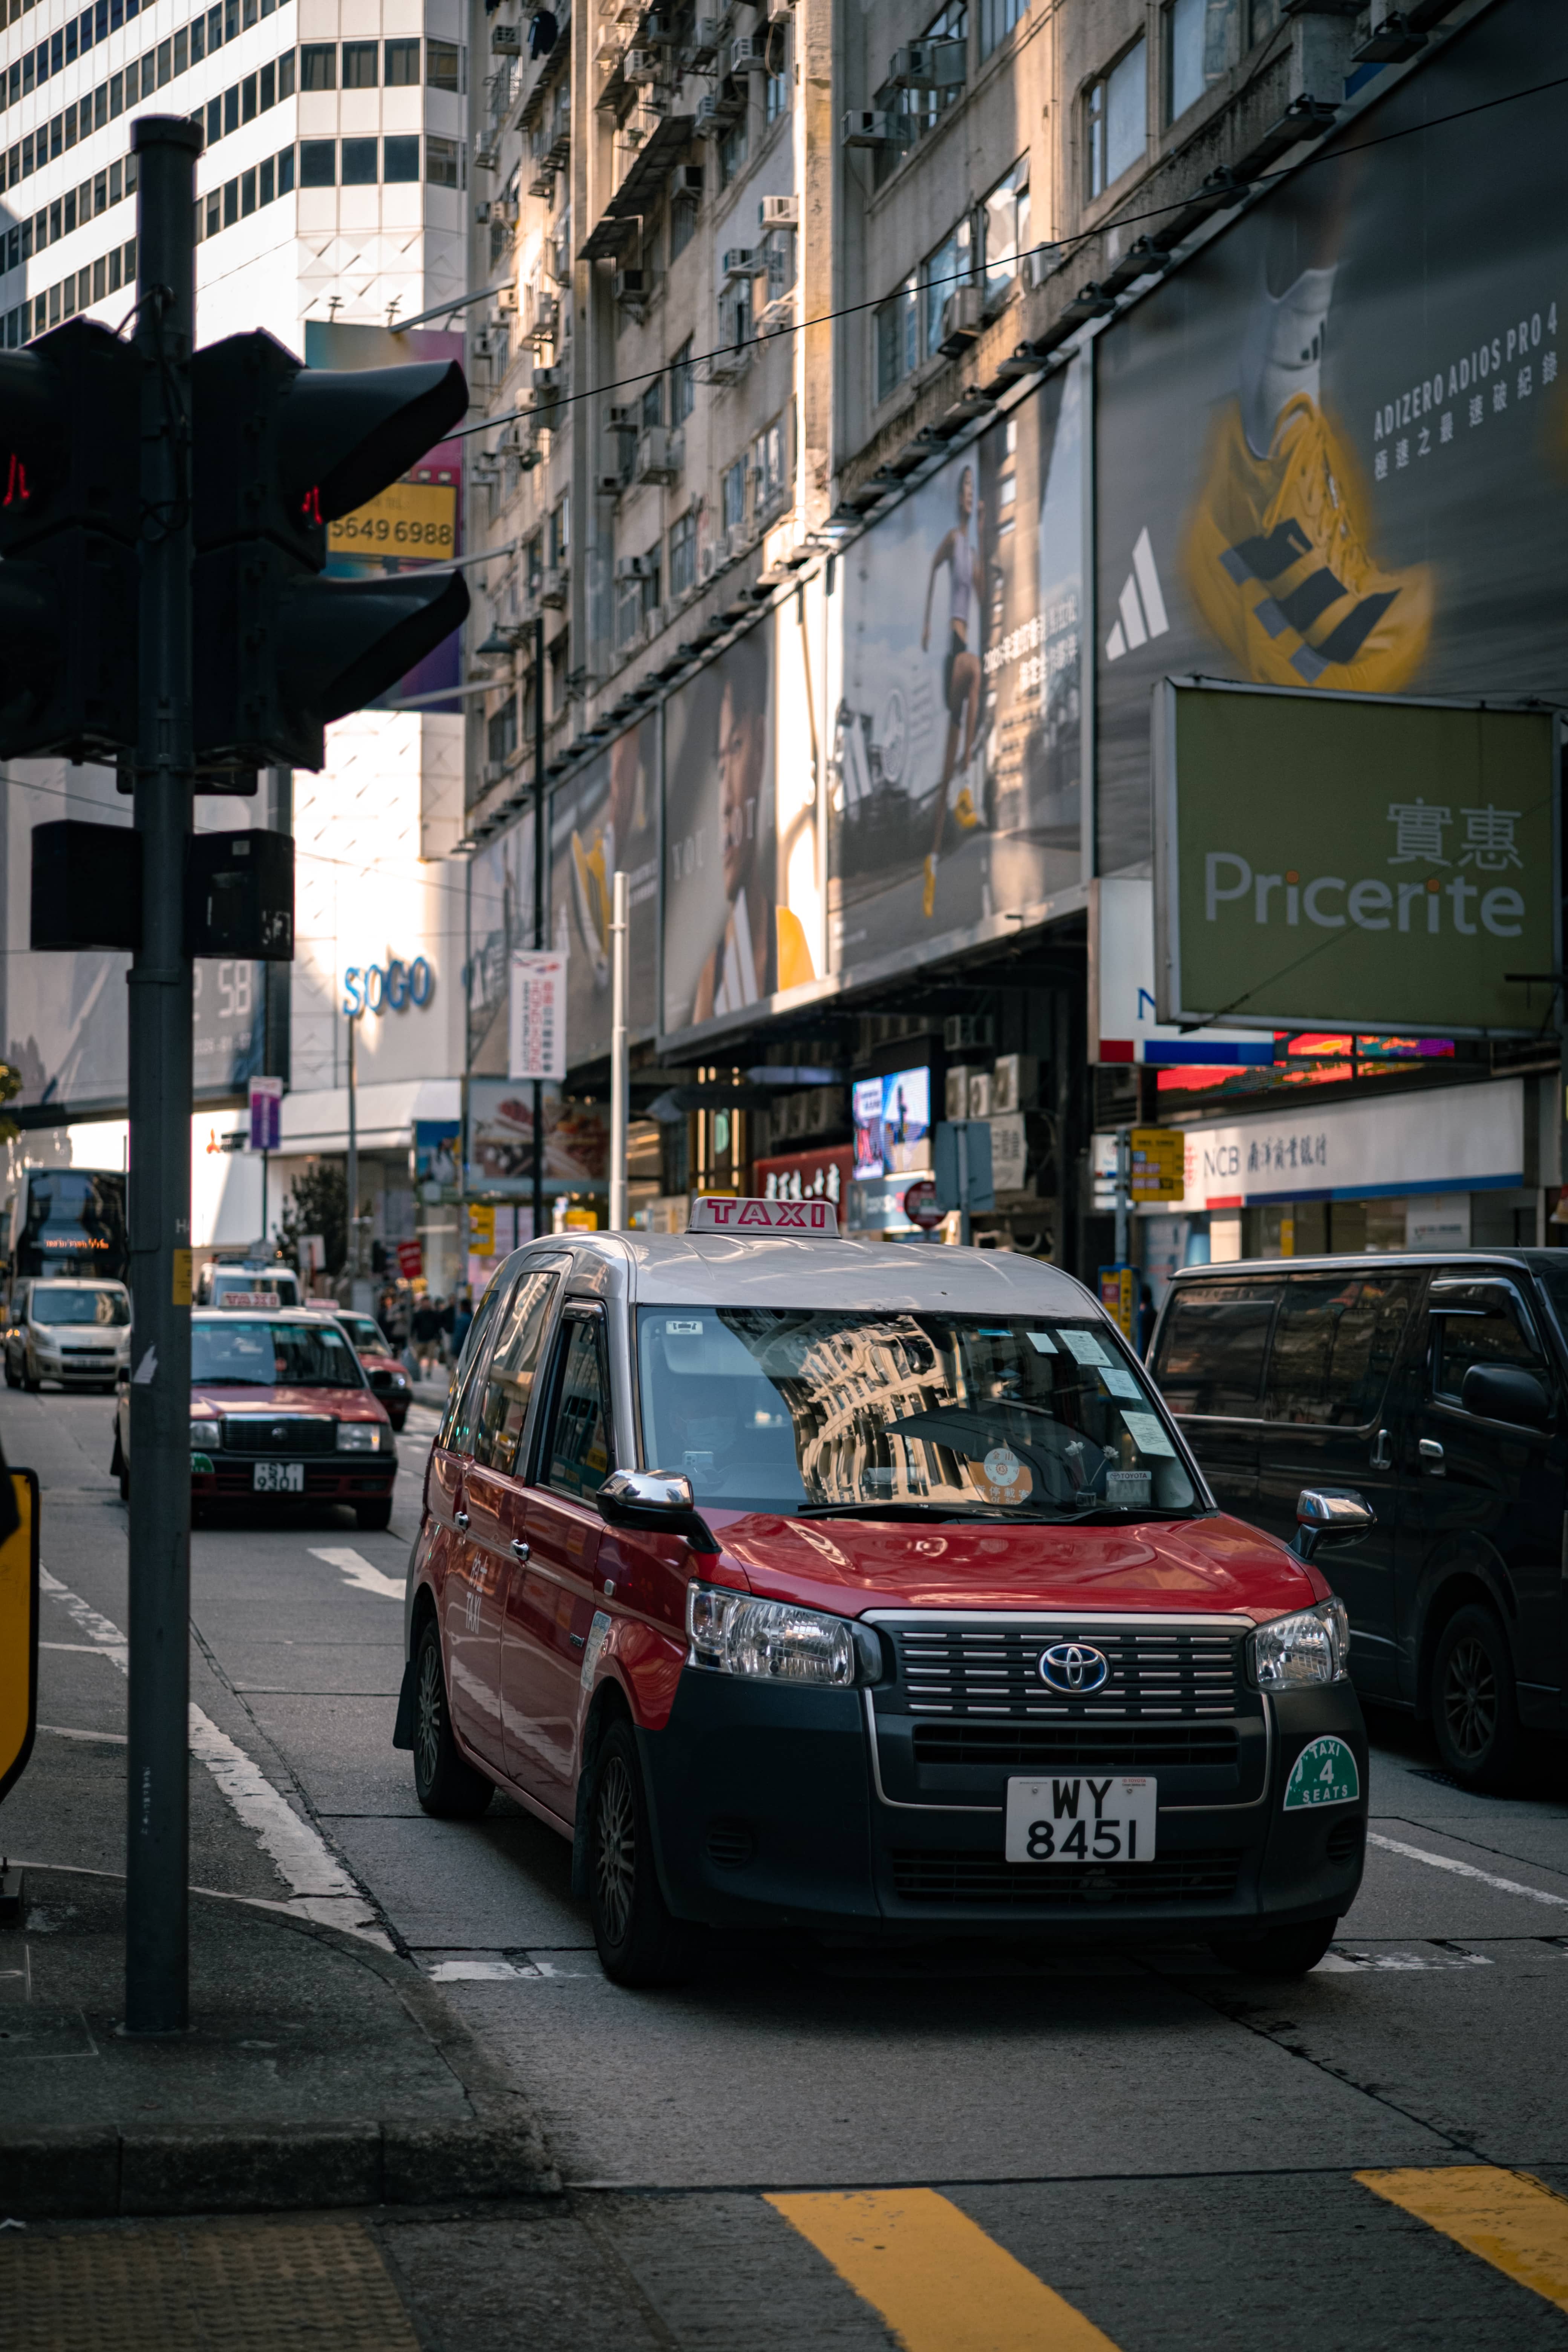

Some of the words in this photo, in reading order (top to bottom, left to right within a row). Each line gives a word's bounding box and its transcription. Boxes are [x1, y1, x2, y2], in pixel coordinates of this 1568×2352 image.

[1374, 374, 1443, 441] ADIZERO
[1448, 338, 1501, 397] ADIOS
[1507, 313, 1541, 362] PRO
[1547, 302, 1557, 335] 4
[331, 517, 389, 541] 5649
[394, 521, 452, 545] 6988
[1387, 797, 1524, 871] 實惠
[1205, 851, 1525, 937] Pricerite
[343, 956, 431, 1015] SOGO
[1204, 1146, 1240, 1178] NCB
[707, 1199, 825, 1228] TAXI
[226, 1293, 277, 1306] TAXI
[257, 1476, 297, 1489] 9301
[466, 1591, 482, 1634] TAXI
[1311, 1741, 1340, 1759] TAXI
[1320, 1759, 1334, 1784] 4
[1052, 1779, 1113, 1819] WY
[1302, 1784, 1348, 1802] SEATS
[1026, 1820, 1136, 1860] 8451
